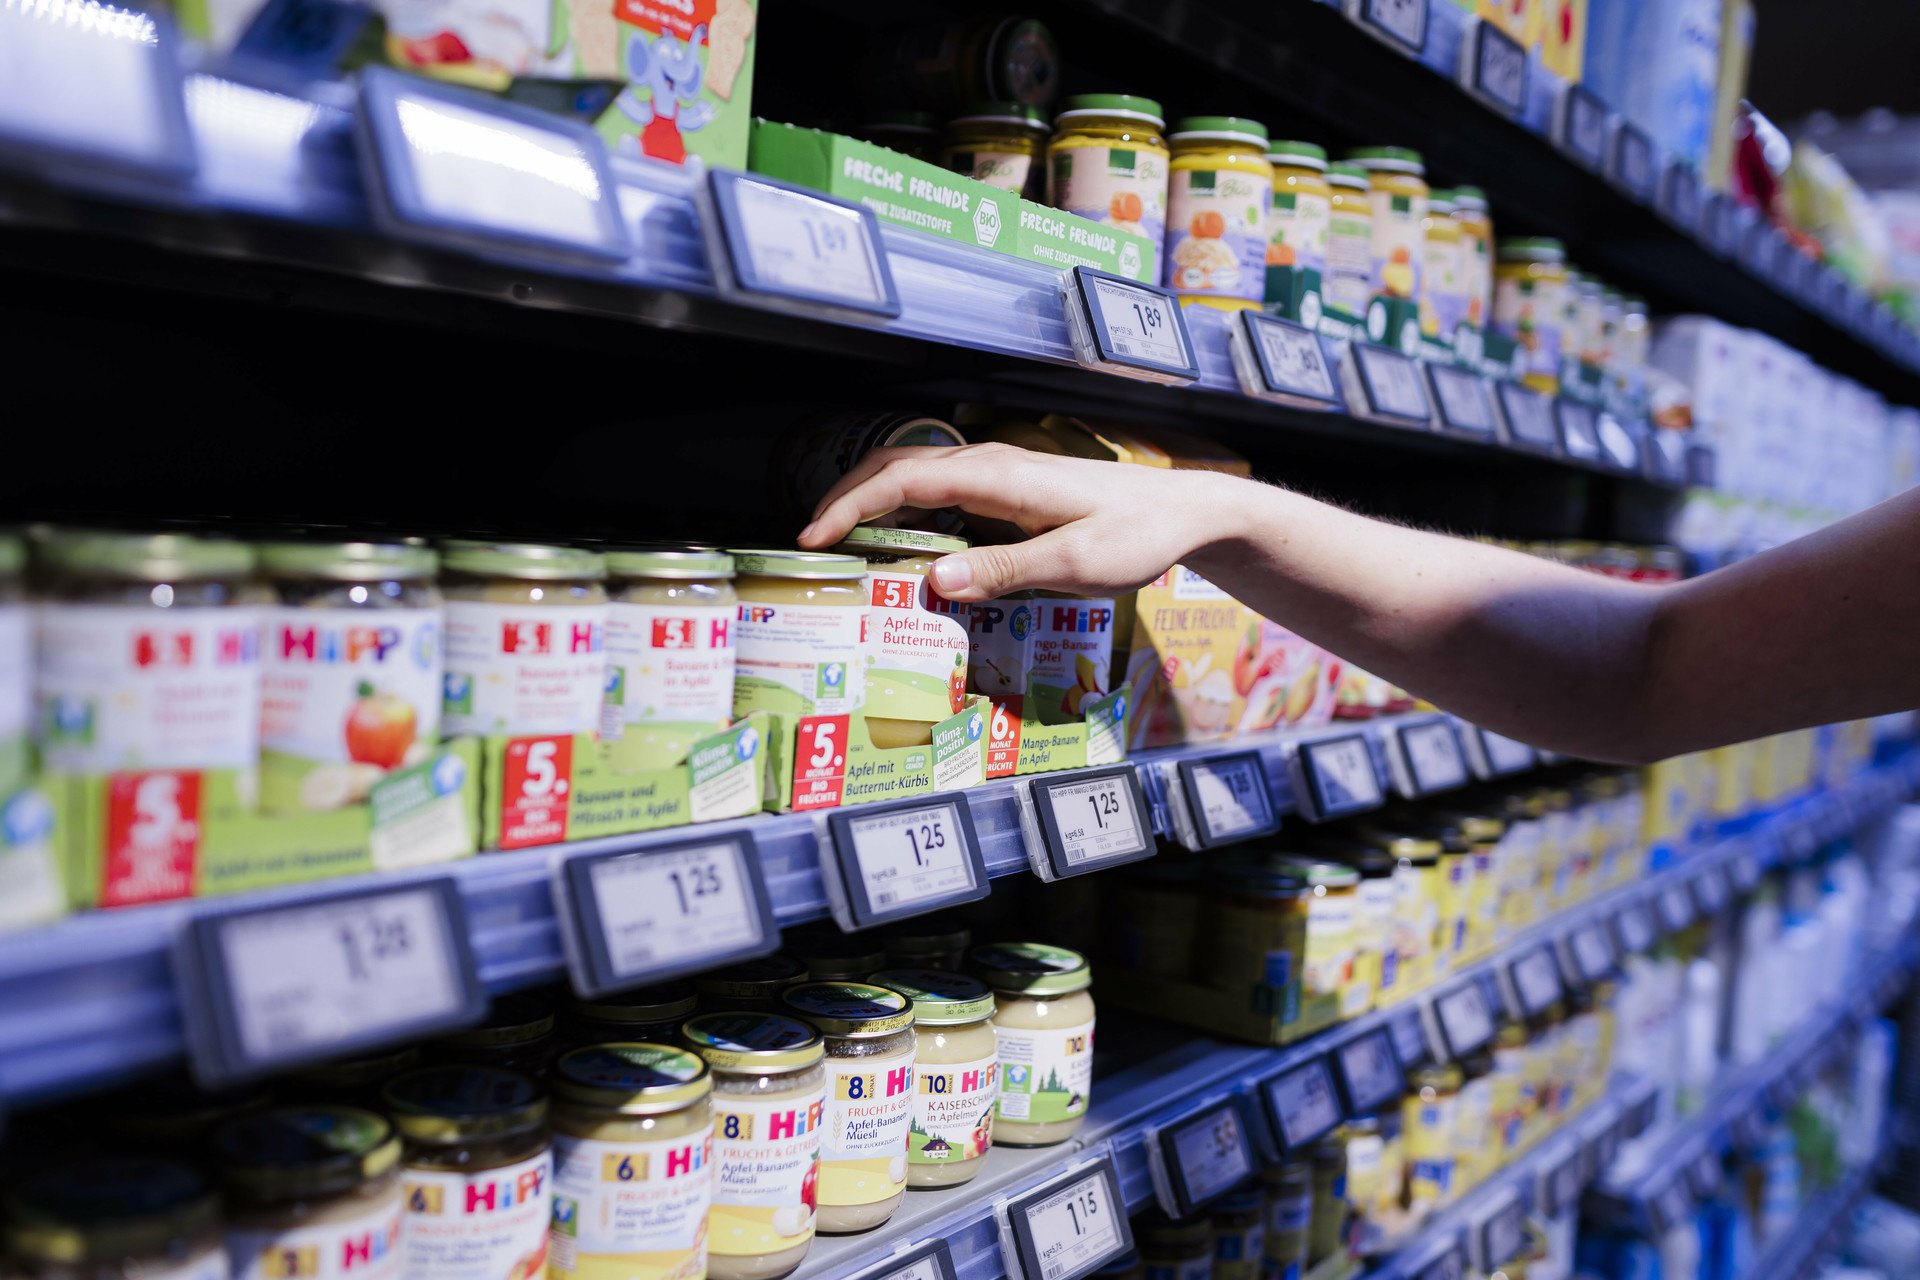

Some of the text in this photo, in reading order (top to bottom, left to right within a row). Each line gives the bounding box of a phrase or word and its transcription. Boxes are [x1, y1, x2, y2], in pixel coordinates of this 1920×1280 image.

[844, 156, 970, 213] FRECHE FREUNDE
[888, 204, 953, 234] ZUSATZSTOFFE
[1020, 210, 1117, 255] FRECHE FREUNDE
[1033, 244, 1054, 261] OHNE
[1133, 303, 1162, 339] 1,89
[883, 581, 906, 608] 5.
[905, 582, 914, 608] MONAT
[884, 616, 943, 633] Apfel mit
[1052, 606, 1111, 634] HiPP
[883, 631, 968, 650] Butternut-Kürbis
[882, 648, 899, 656] OHNE
[991, 702, 1016, 740] 6.
[810, 722, 844, 769] 5.
[935, 726, 964, 748] Klima-
[989, 740, 1012, 750] MONAT
[1021, 734, 1081, 752] Mango-Banane
[937, 735, 966, 763] positiv
[994, 751, 1007, 761] BIO
[1020, 751, 1051, 767] in Apfel
[522, 740, 569, 797] 5.
[847, 761, 895, 780] Apfel mit
[845, 772, 930, 797] Butternut-Kürbis
[1088, 791, 1119, 830] 1,25
[905, 822, 946, 867] 1,25
[848, 1075, 868, 1100] 8.
[927, 1074, 947, 1094] 10.
[848, 1103, 888, 1118] FRUCHT
[890, 1101, 897, 1111] &
[926, 1108, 979, 1125] in Apfelmus
[723, 1114, 745, 1140] 8.
[847, 1111, 908, 1131] Apfel-Bananen-
[845, 1129, 879, 1141] Müesli
[845, 1135, 900, 1151] OHNE ZUCKERZUSATZ
[722, 1147, 771, 1161] FRUCHT
[774, 1147, 783, 1158] &
[721, 1158, 802, 1174] Apfel-Bananen-
[464, 1162, 548, 1214] HiPP
[720, 1173, 758, 1185] Müesli
[1066, 1191, 1097, 1236] 1,15
